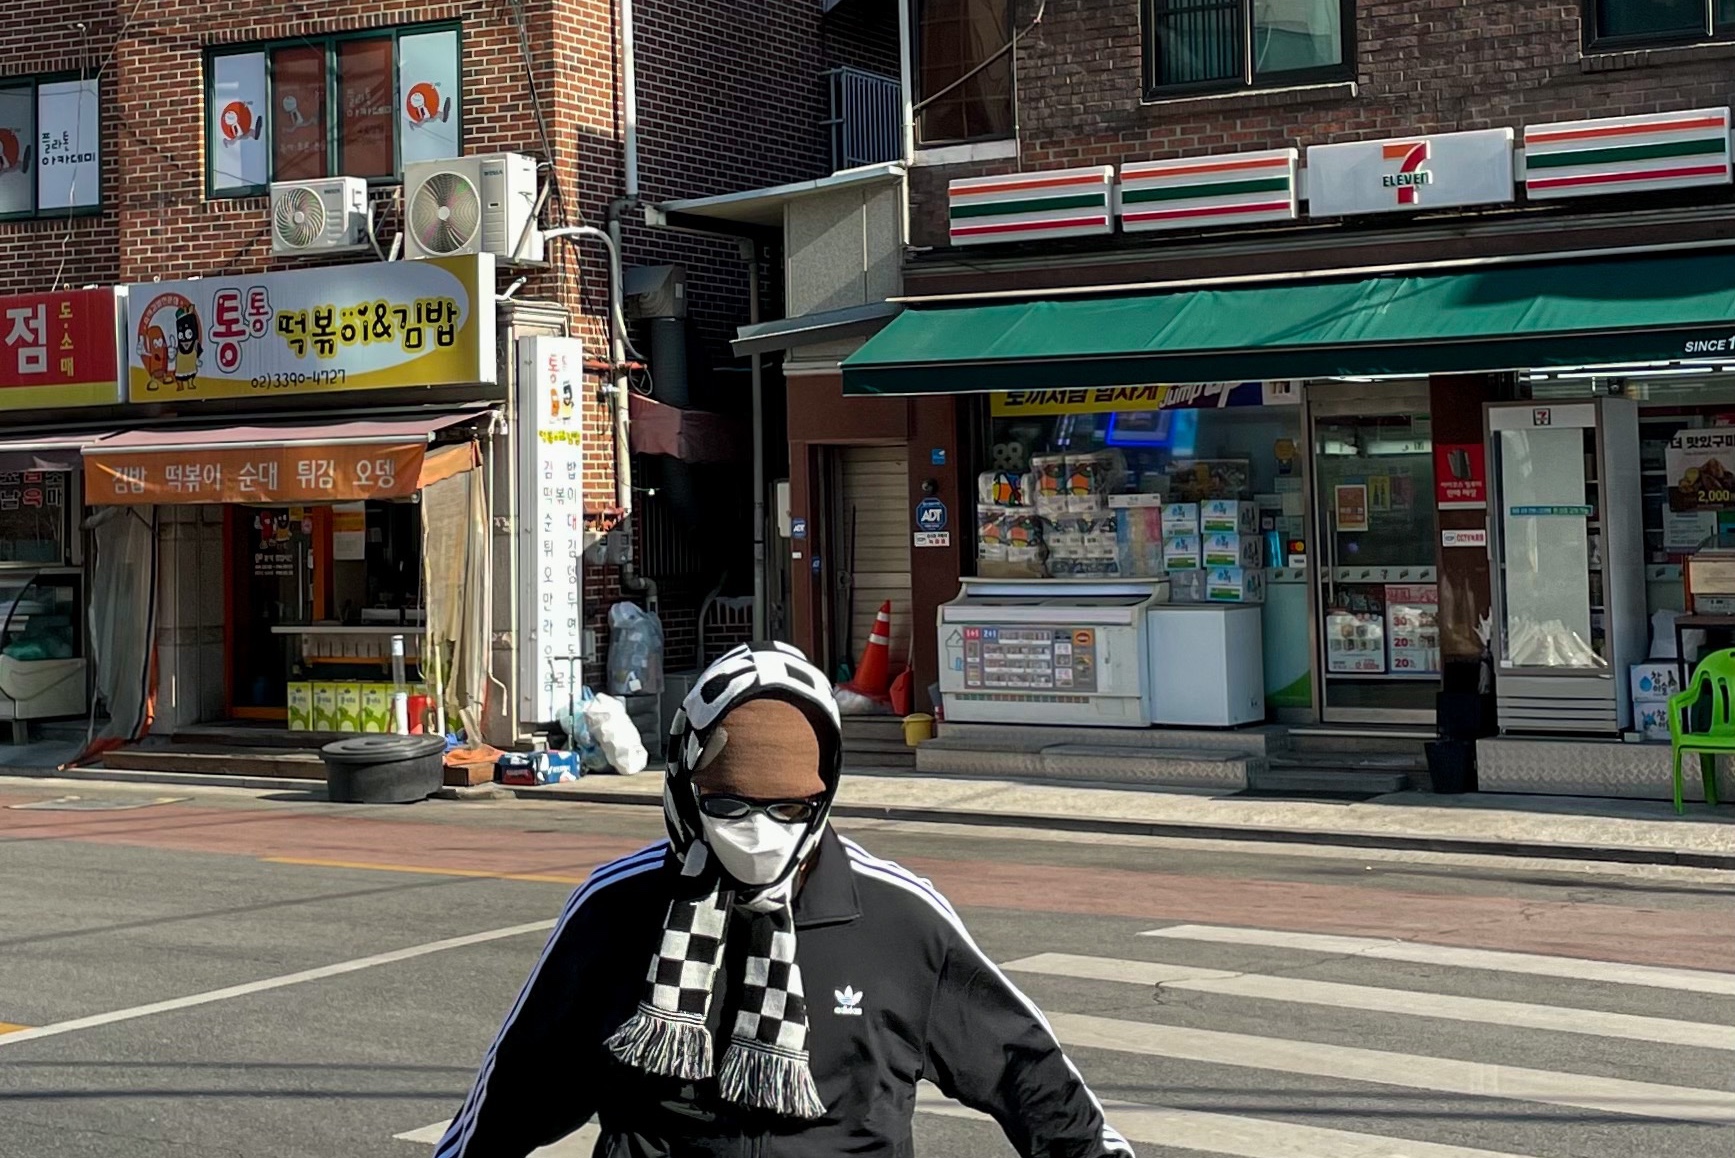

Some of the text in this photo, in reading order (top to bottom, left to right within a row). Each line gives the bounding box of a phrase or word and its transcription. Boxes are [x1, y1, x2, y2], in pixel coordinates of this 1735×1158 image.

[42, 131, 69, 154] 플라톤
[42, 152, 95, 166] 아카데미
[5, 303, 48, 375] 점
[211, 289, 271, 370] 통통
[1684, 339, 1726, 353] SINCE
[251, 369, 346, 389] 02)3390-4727
[112, 459, 395, 494] 김밥 떡볶이 순대 튀김 오뎅
[1698, 490, 1730, 502] 2,000
[920, 508, 943, 522] ADT
